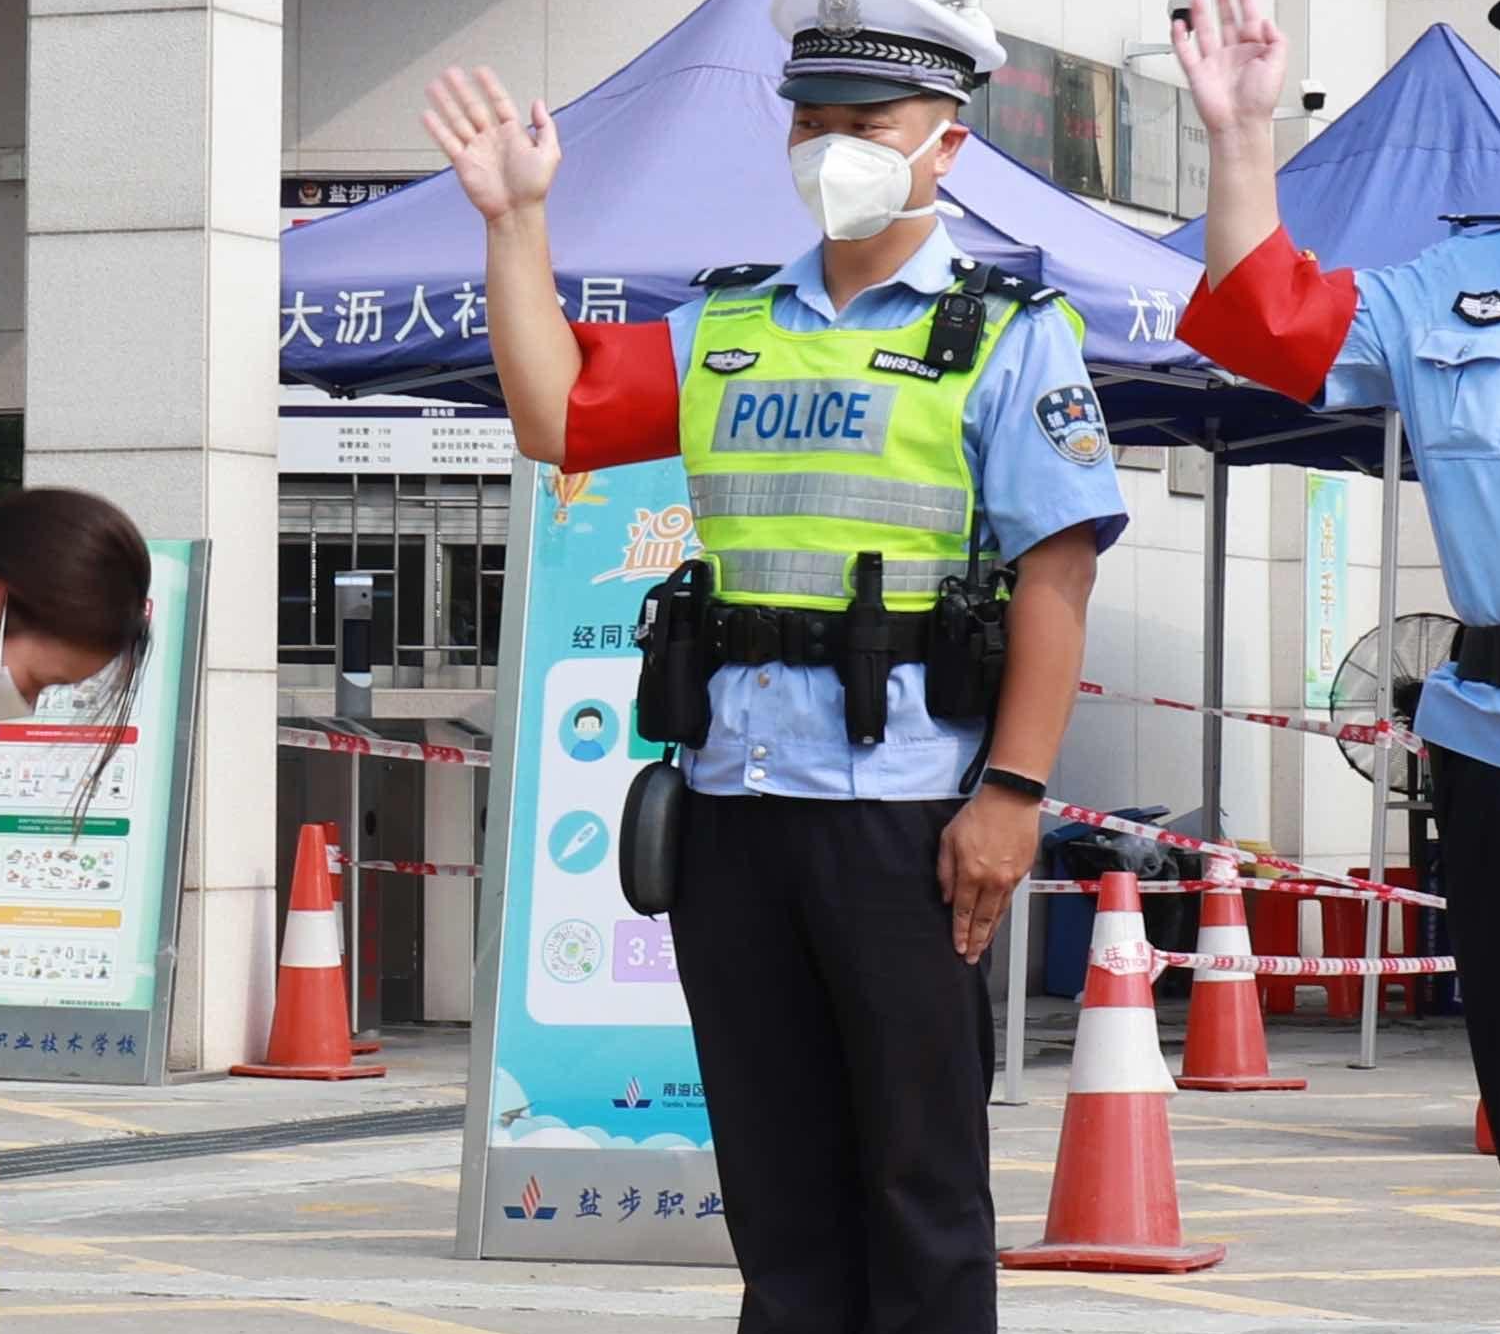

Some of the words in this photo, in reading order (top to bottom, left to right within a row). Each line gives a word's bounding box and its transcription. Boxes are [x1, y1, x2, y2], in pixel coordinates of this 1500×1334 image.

[281, 277, 627, 349] 大沥人社局
[730, 392, 871, 439] POLICE
